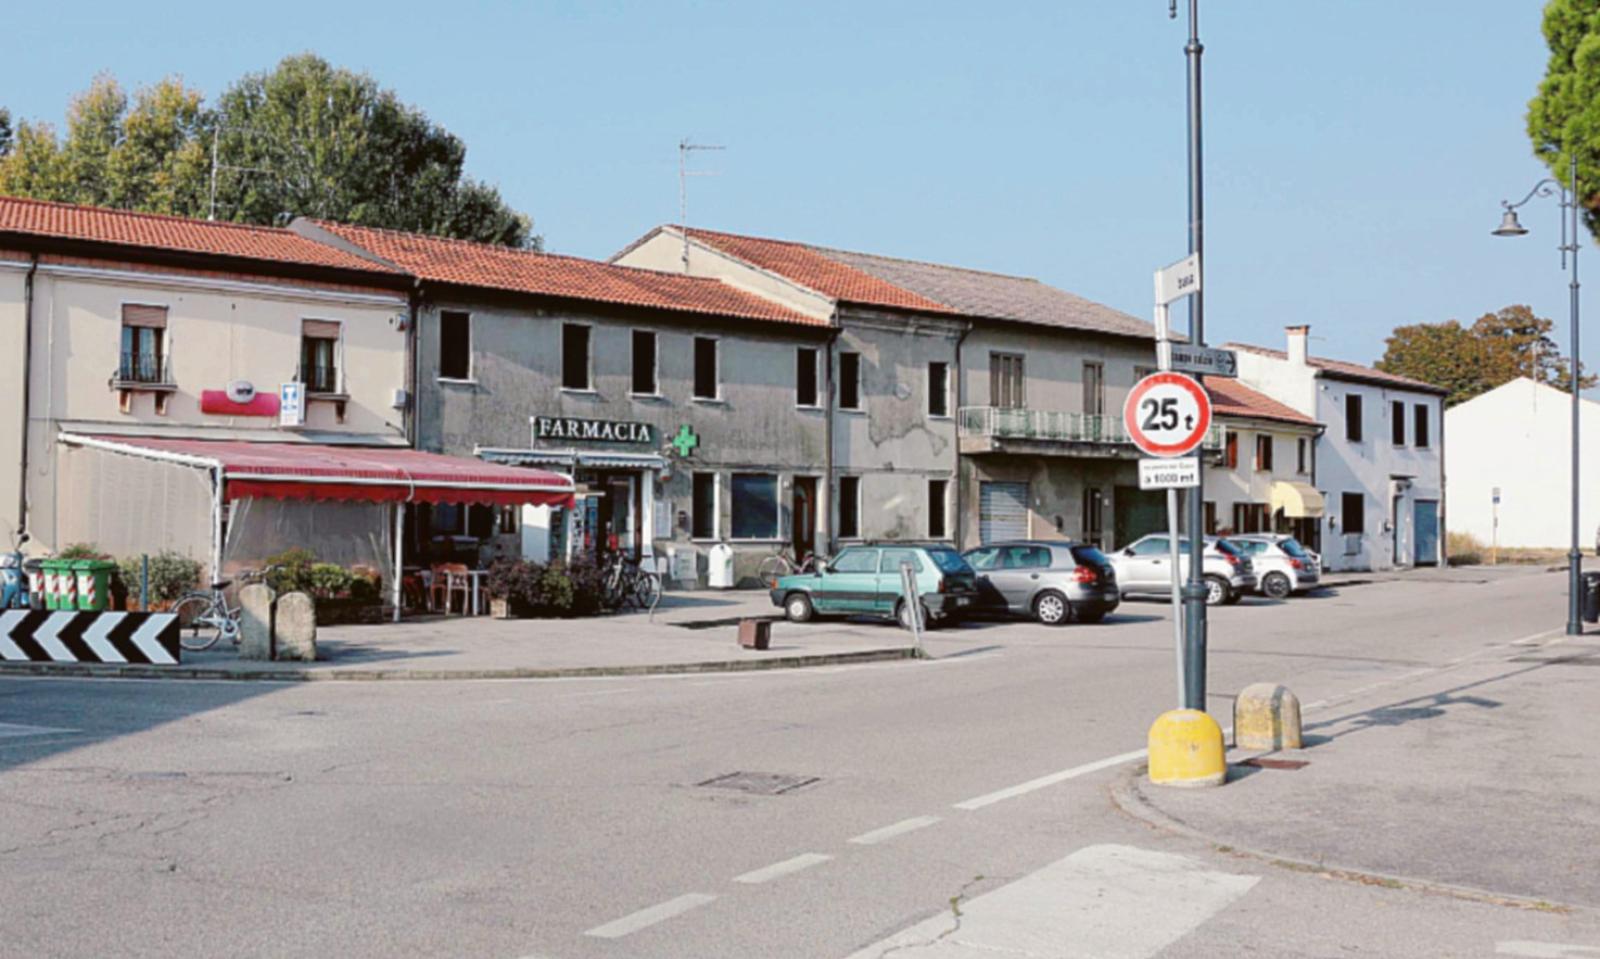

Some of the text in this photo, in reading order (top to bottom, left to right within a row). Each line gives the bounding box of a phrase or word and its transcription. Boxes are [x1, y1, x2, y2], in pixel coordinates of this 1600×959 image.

[1141, 398, 1194, 430] 25 t
[538, 418, 650, 442] FARMACIA
